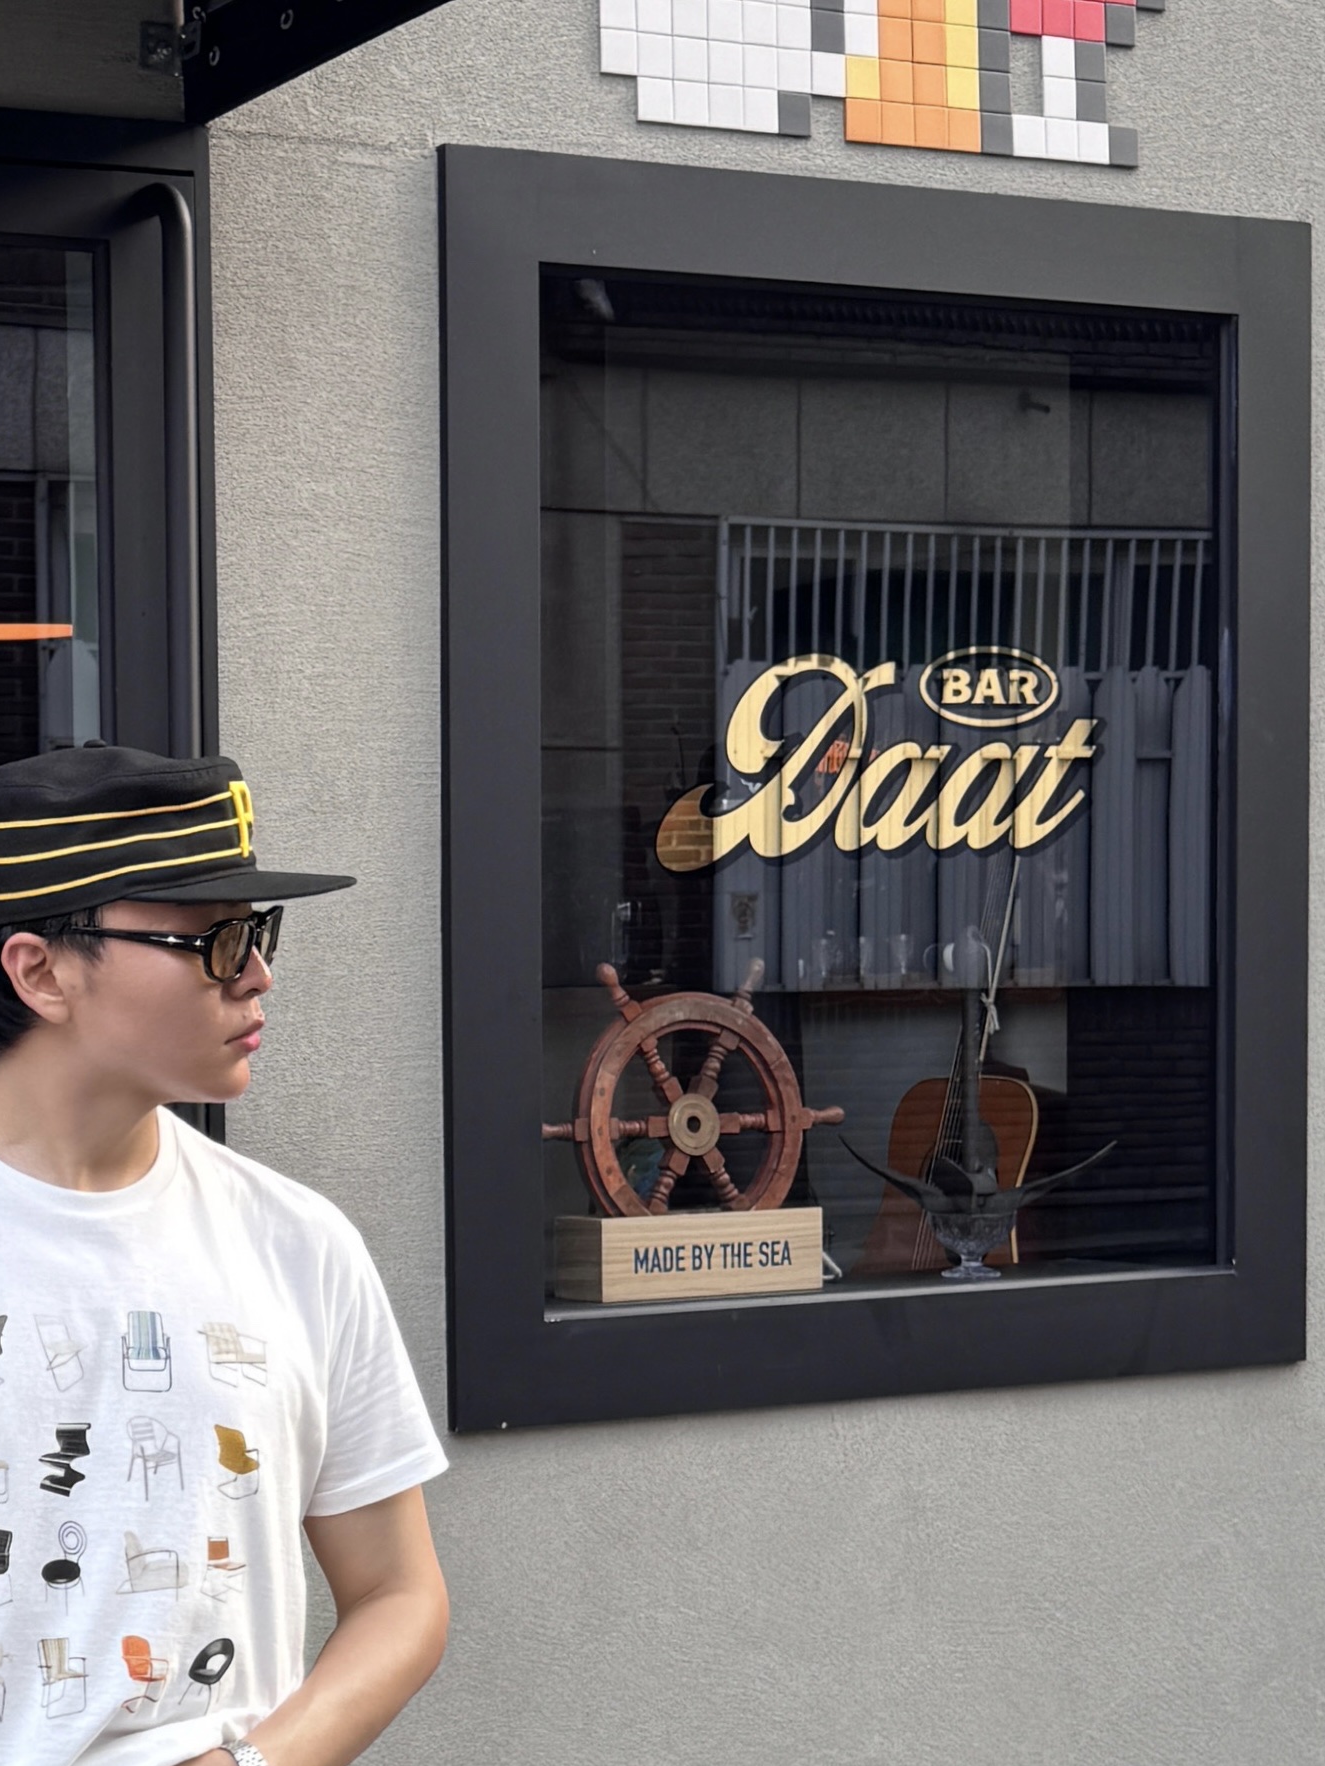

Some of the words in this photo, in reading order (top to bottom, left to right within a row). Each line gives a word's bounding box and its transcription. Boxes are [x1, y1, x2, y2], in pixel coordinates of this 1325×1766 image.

[941, 668, 1040, 705] BAR
[654, 652, 1098, 873] Daat
[633, 1246, 686, 1275] MADE
[691, 1243, 715, 1271] BY
[720, 1241, 753, 1270] THE
[758, 1239, 793, 1267] SEA
